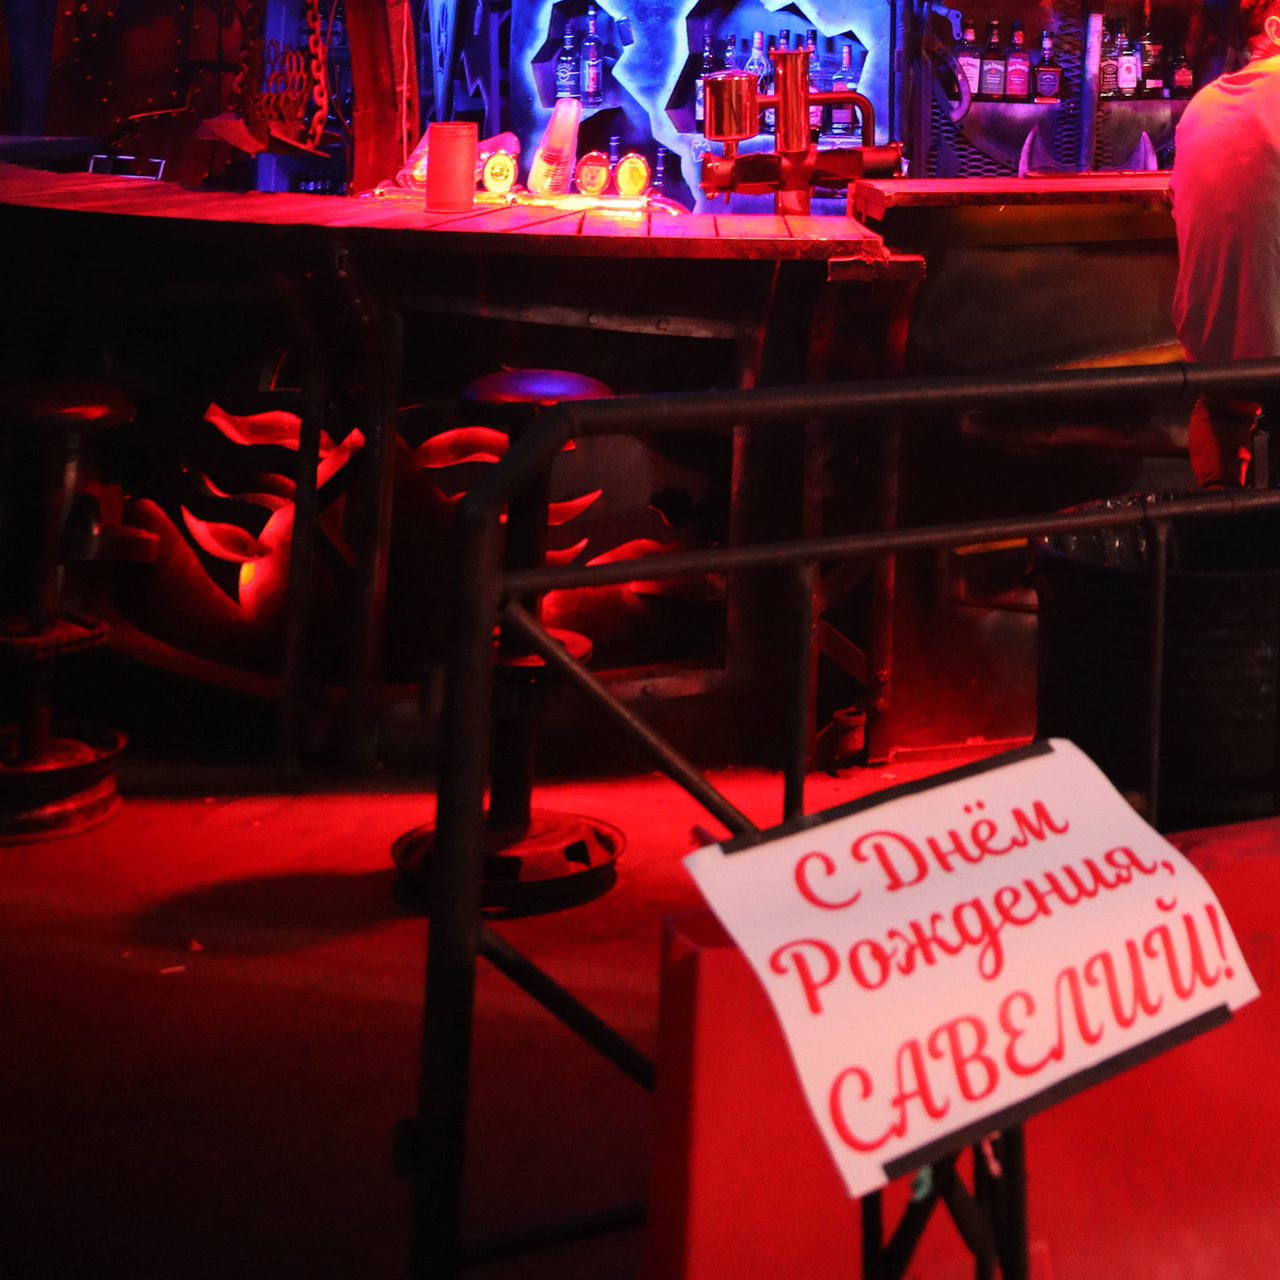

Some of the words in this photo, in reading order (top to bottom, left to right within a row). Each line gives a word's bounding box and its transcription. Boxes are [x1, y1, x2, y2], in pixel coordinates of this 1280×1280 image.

[769, 845, 1175, 1015] Рождения,
[795, 851, 861, 911] С
[852, 800, 1070, 892] Днём
[829, 895, 1236, 1153] САВЕЛИЙ!
